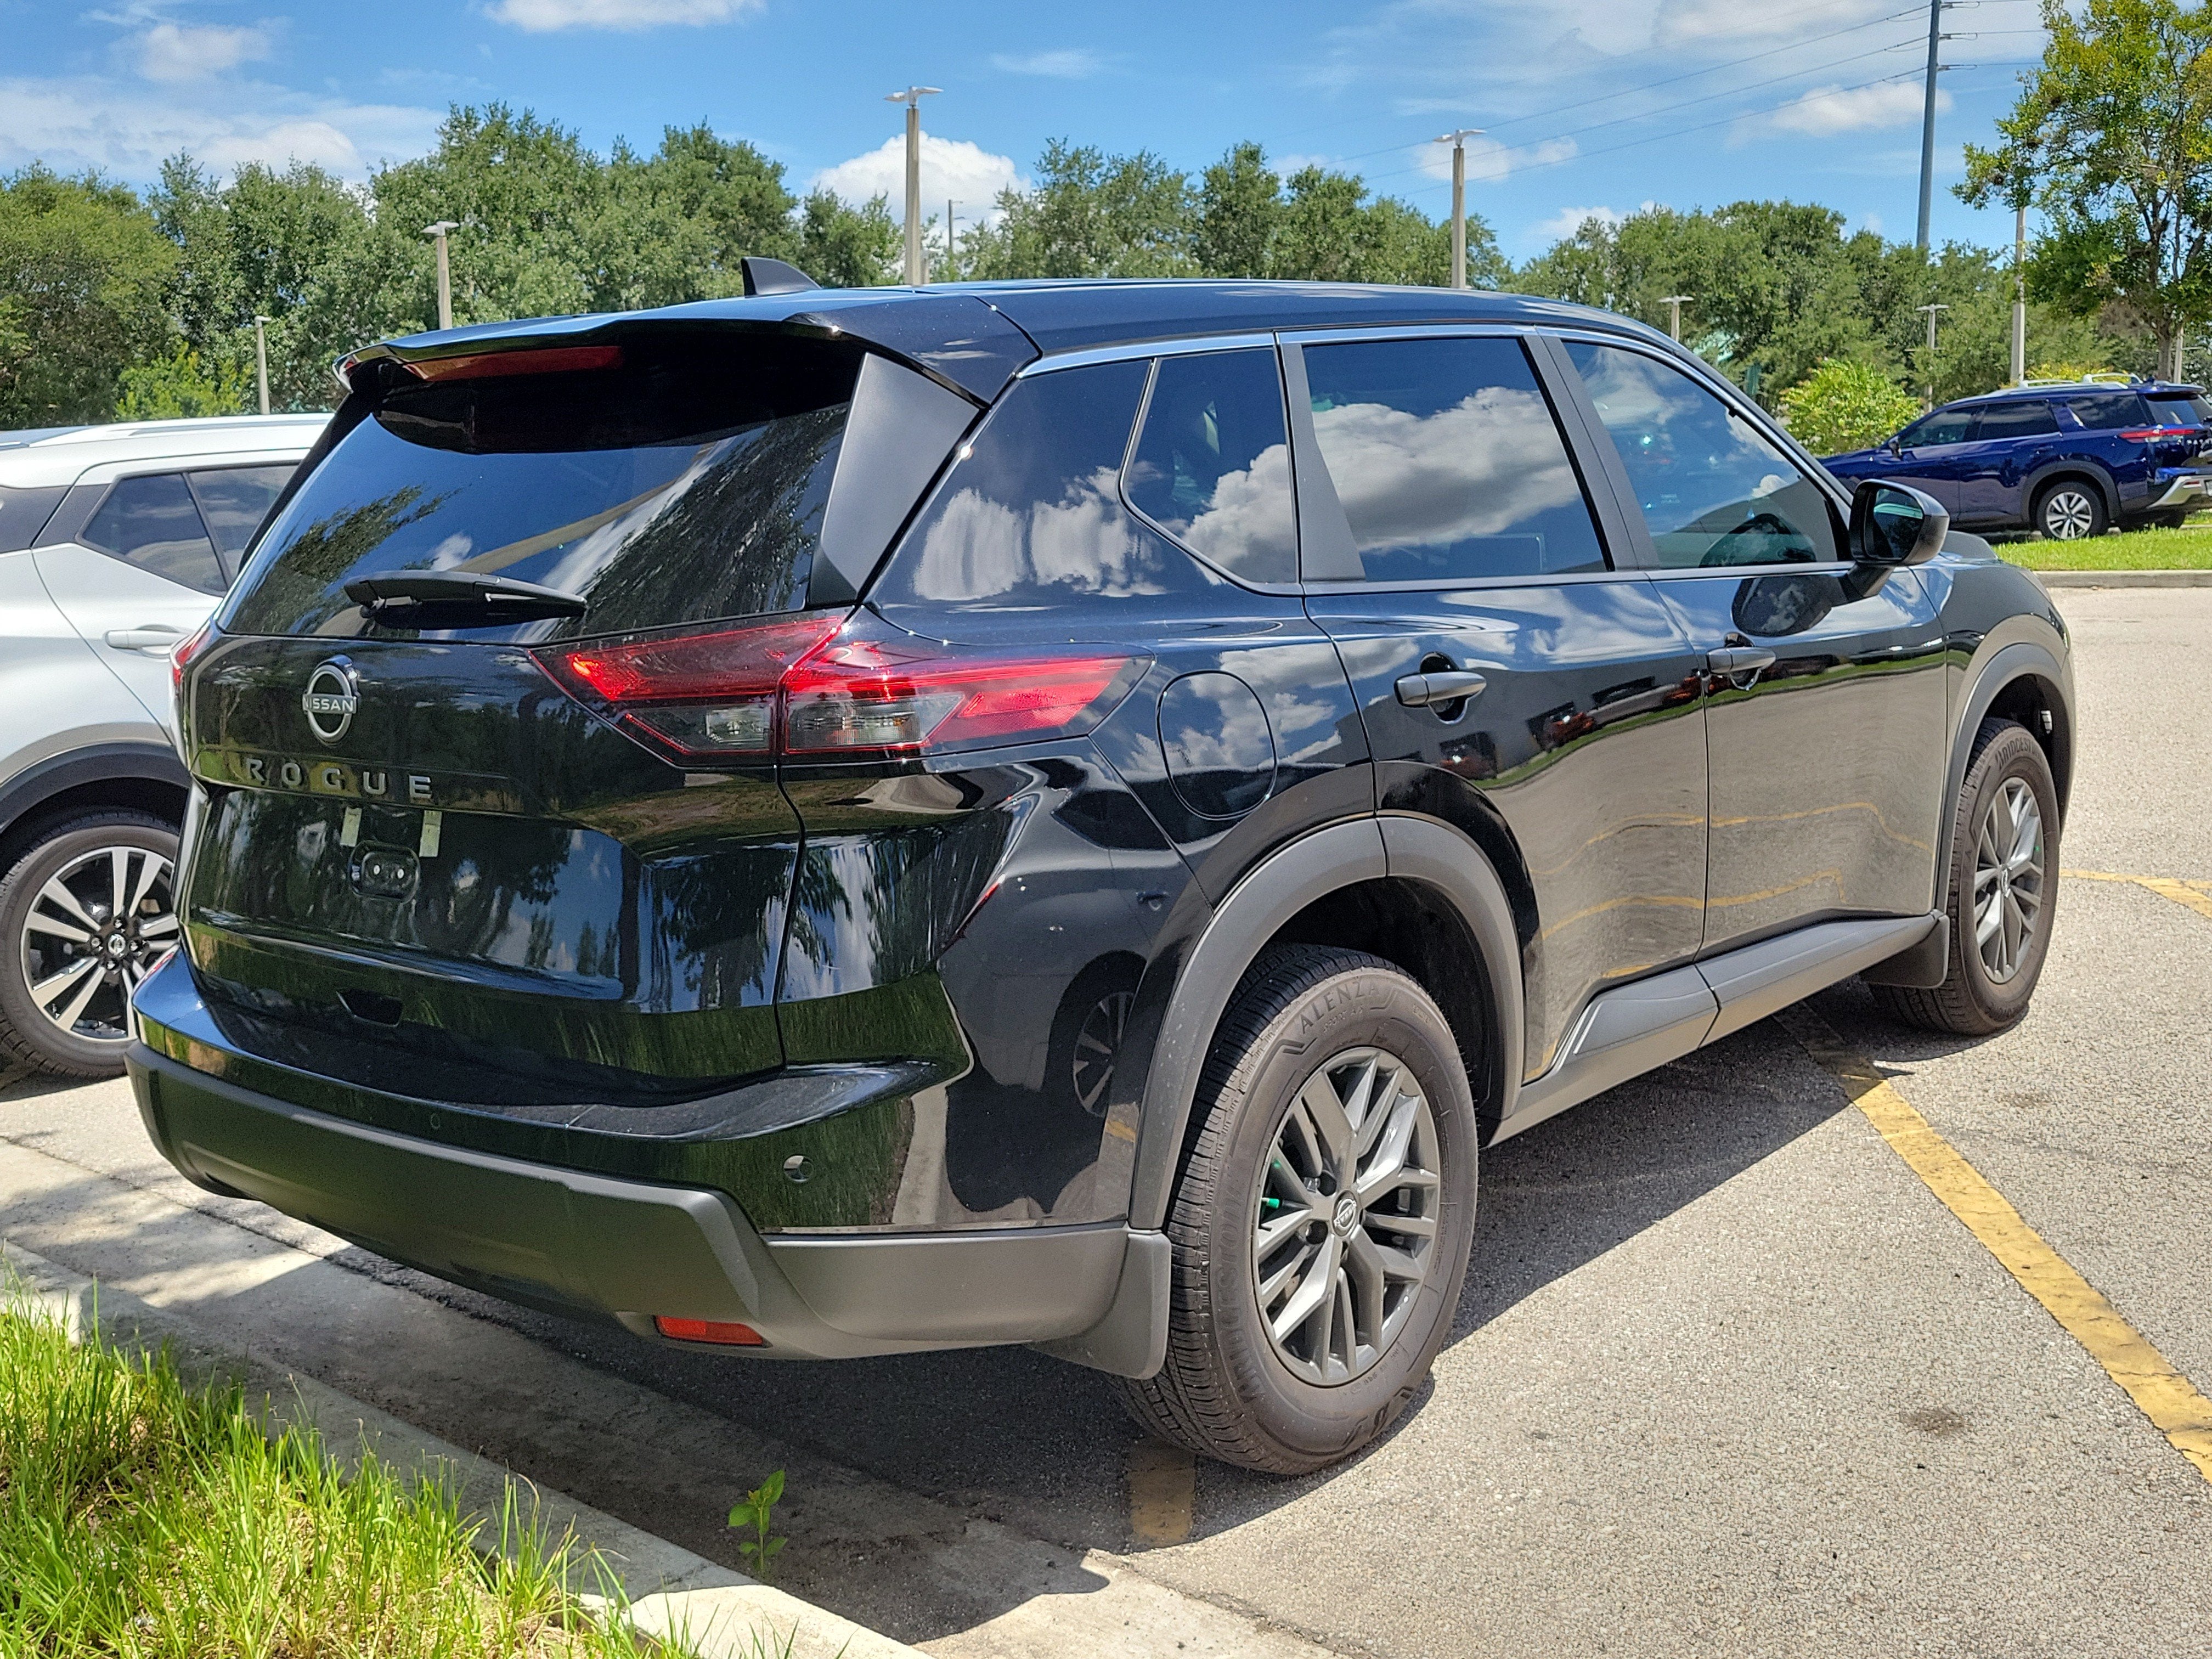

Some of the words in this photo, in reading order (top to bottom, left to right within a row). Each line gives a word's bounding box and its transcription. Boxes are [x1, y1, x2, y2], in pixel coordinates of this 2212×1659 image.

[302, 696, 354, 712] NISSAN
[247, 758, 432, 799] ROGUE
[1301, 980, 1380, 1034] ALENZA
